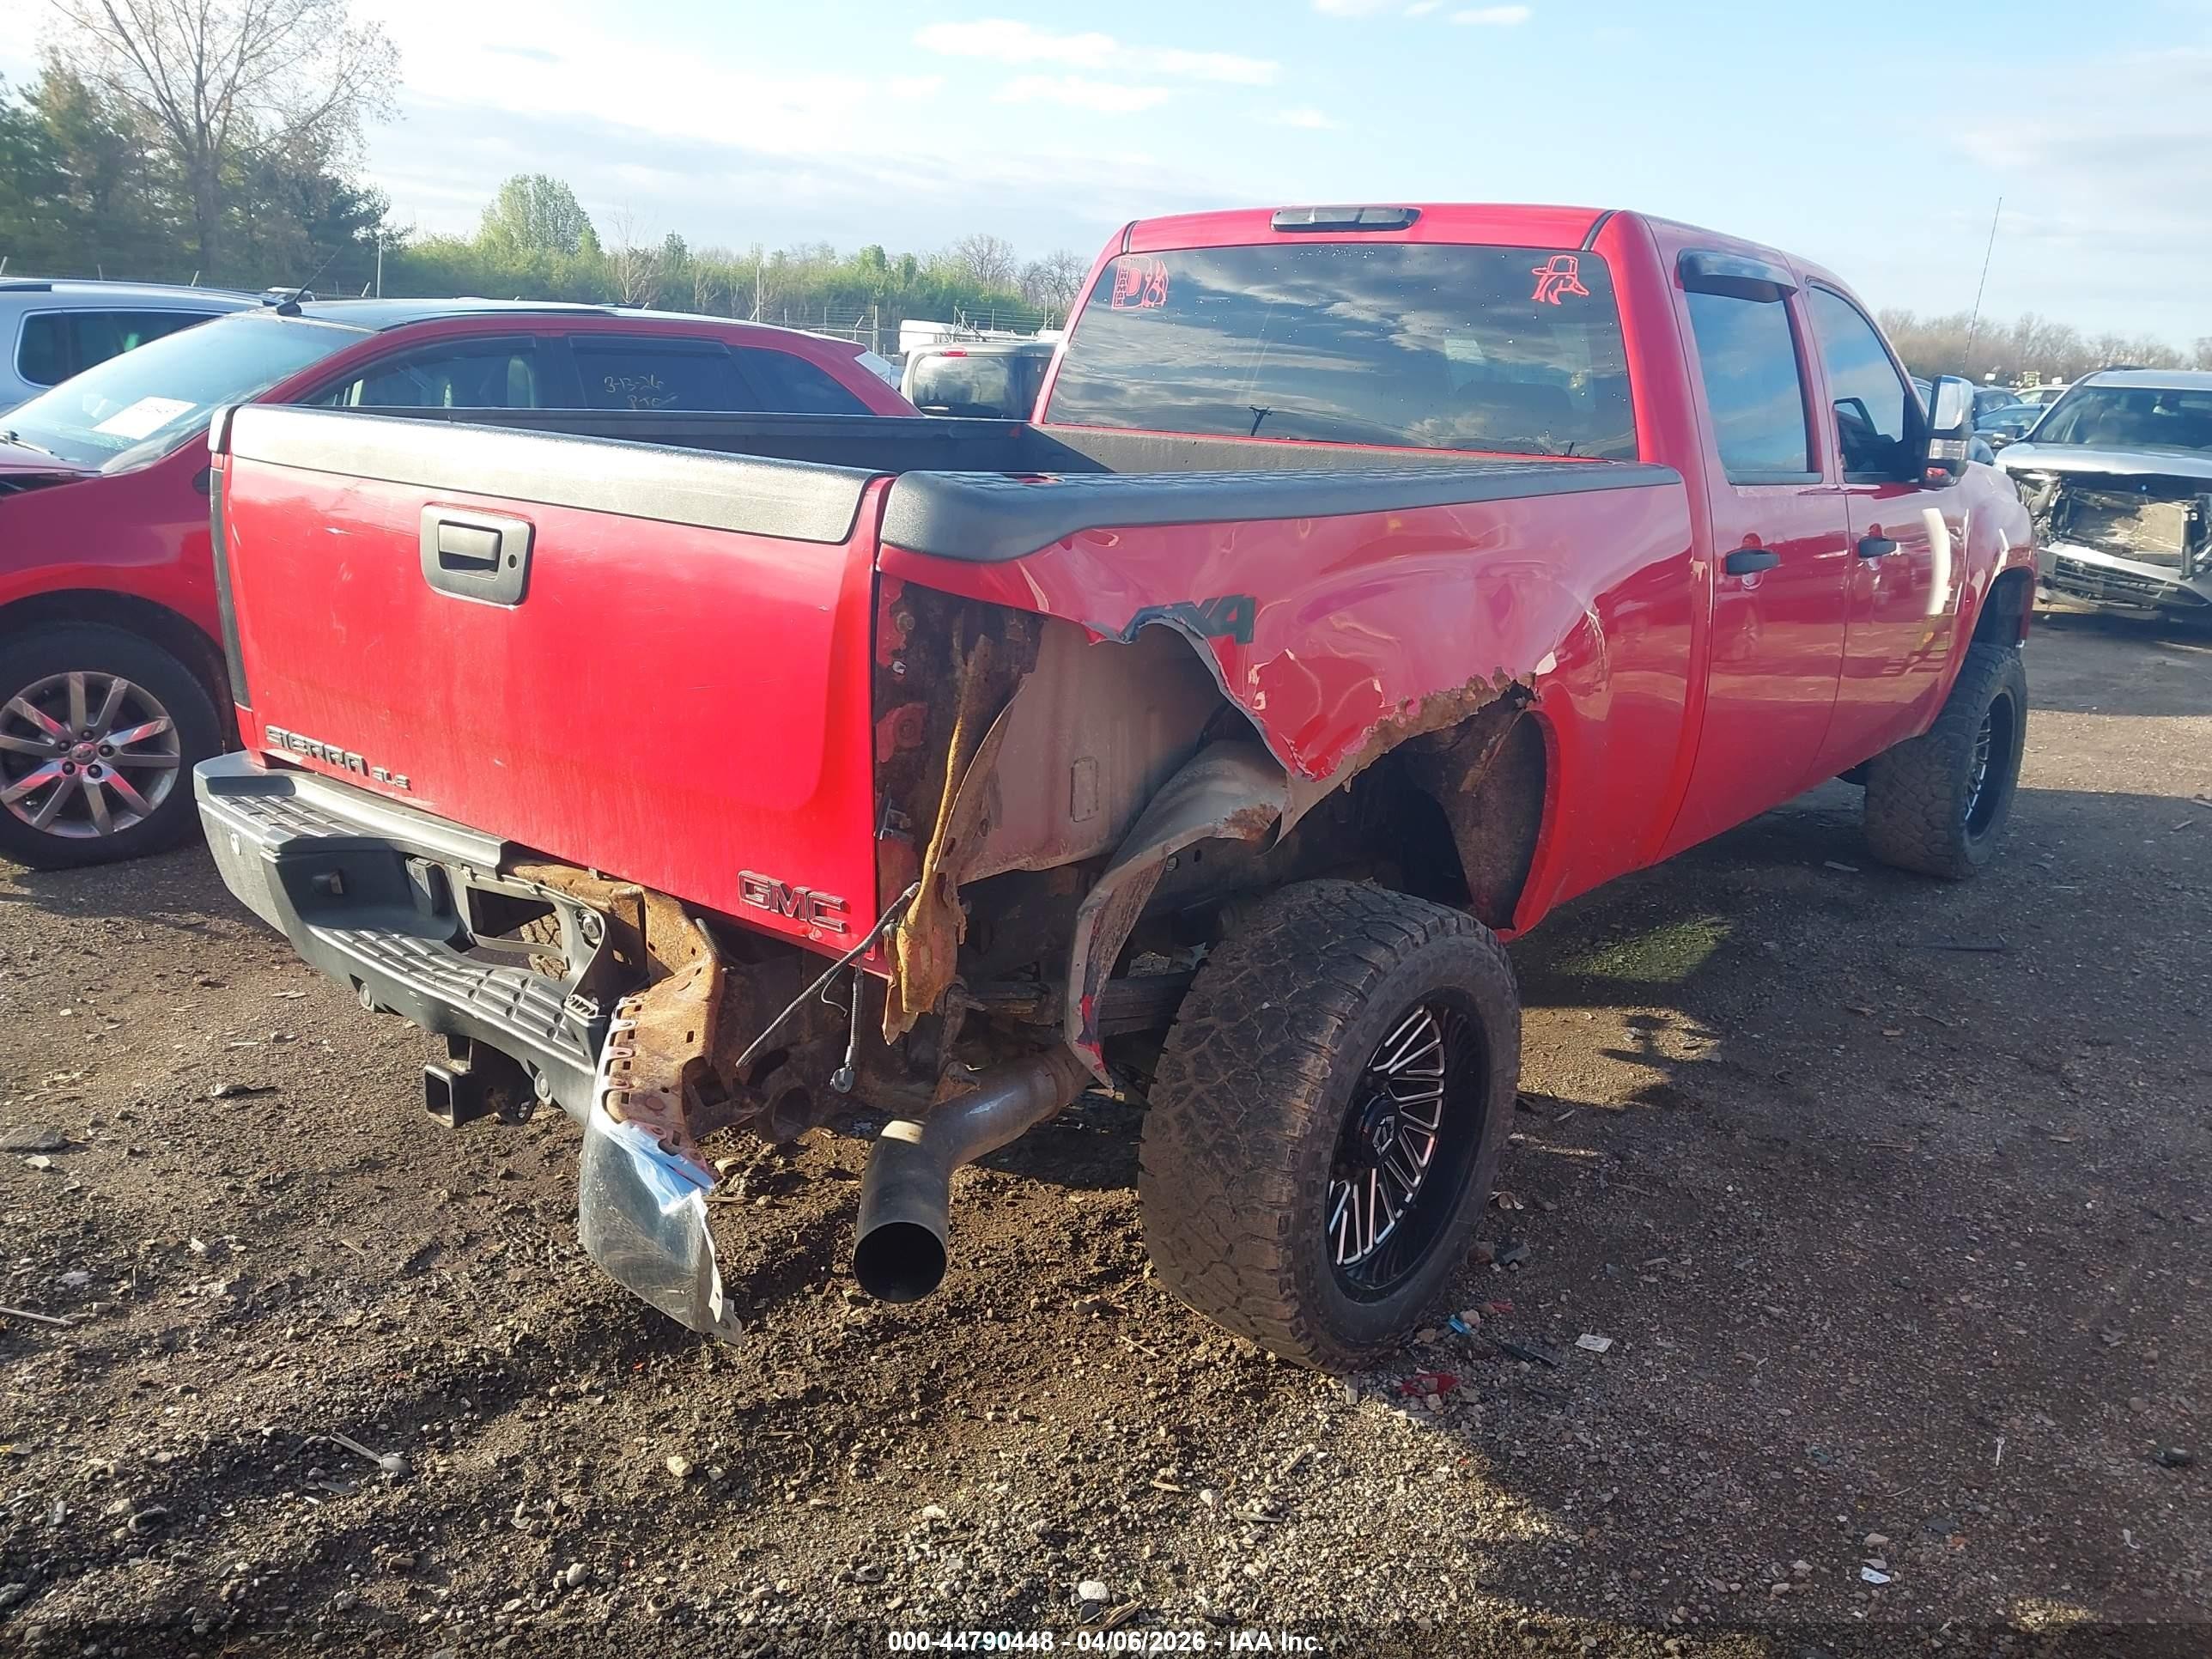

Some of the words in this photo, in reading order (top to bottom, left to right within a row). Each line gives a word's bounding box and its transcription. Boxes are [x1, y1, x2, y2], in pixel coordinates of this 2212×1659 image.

[264, 725, 369, 777] SIERRA
[370, 766, 412, 792] SLE
[738, 869, 848, 933] GMC
